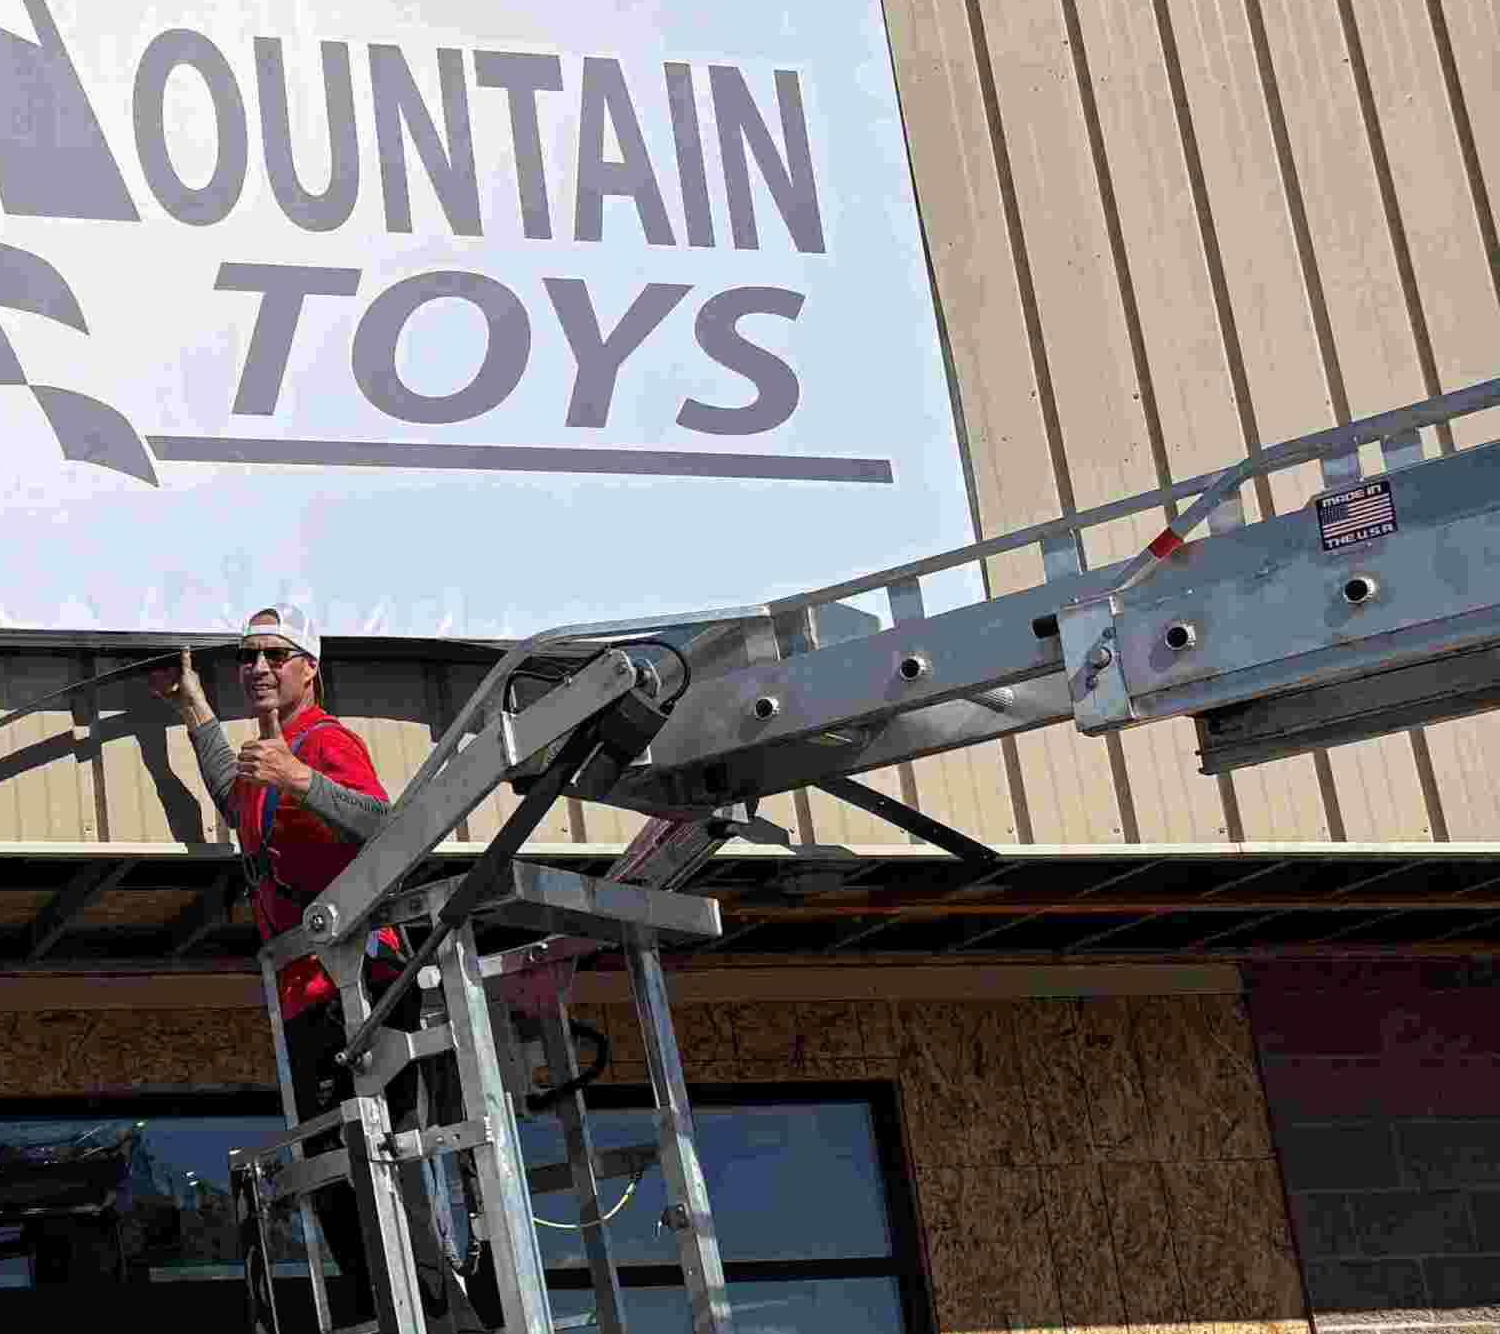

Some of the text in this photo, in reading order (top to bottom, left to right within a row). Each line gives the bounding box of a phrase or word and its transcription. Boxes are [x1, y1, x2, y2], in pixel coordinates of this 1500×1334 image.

[213, 261, 806, 436] TOYS
[1322, 489, 1364, 507] MADE
[1325, 532, 1356, 548] THE
